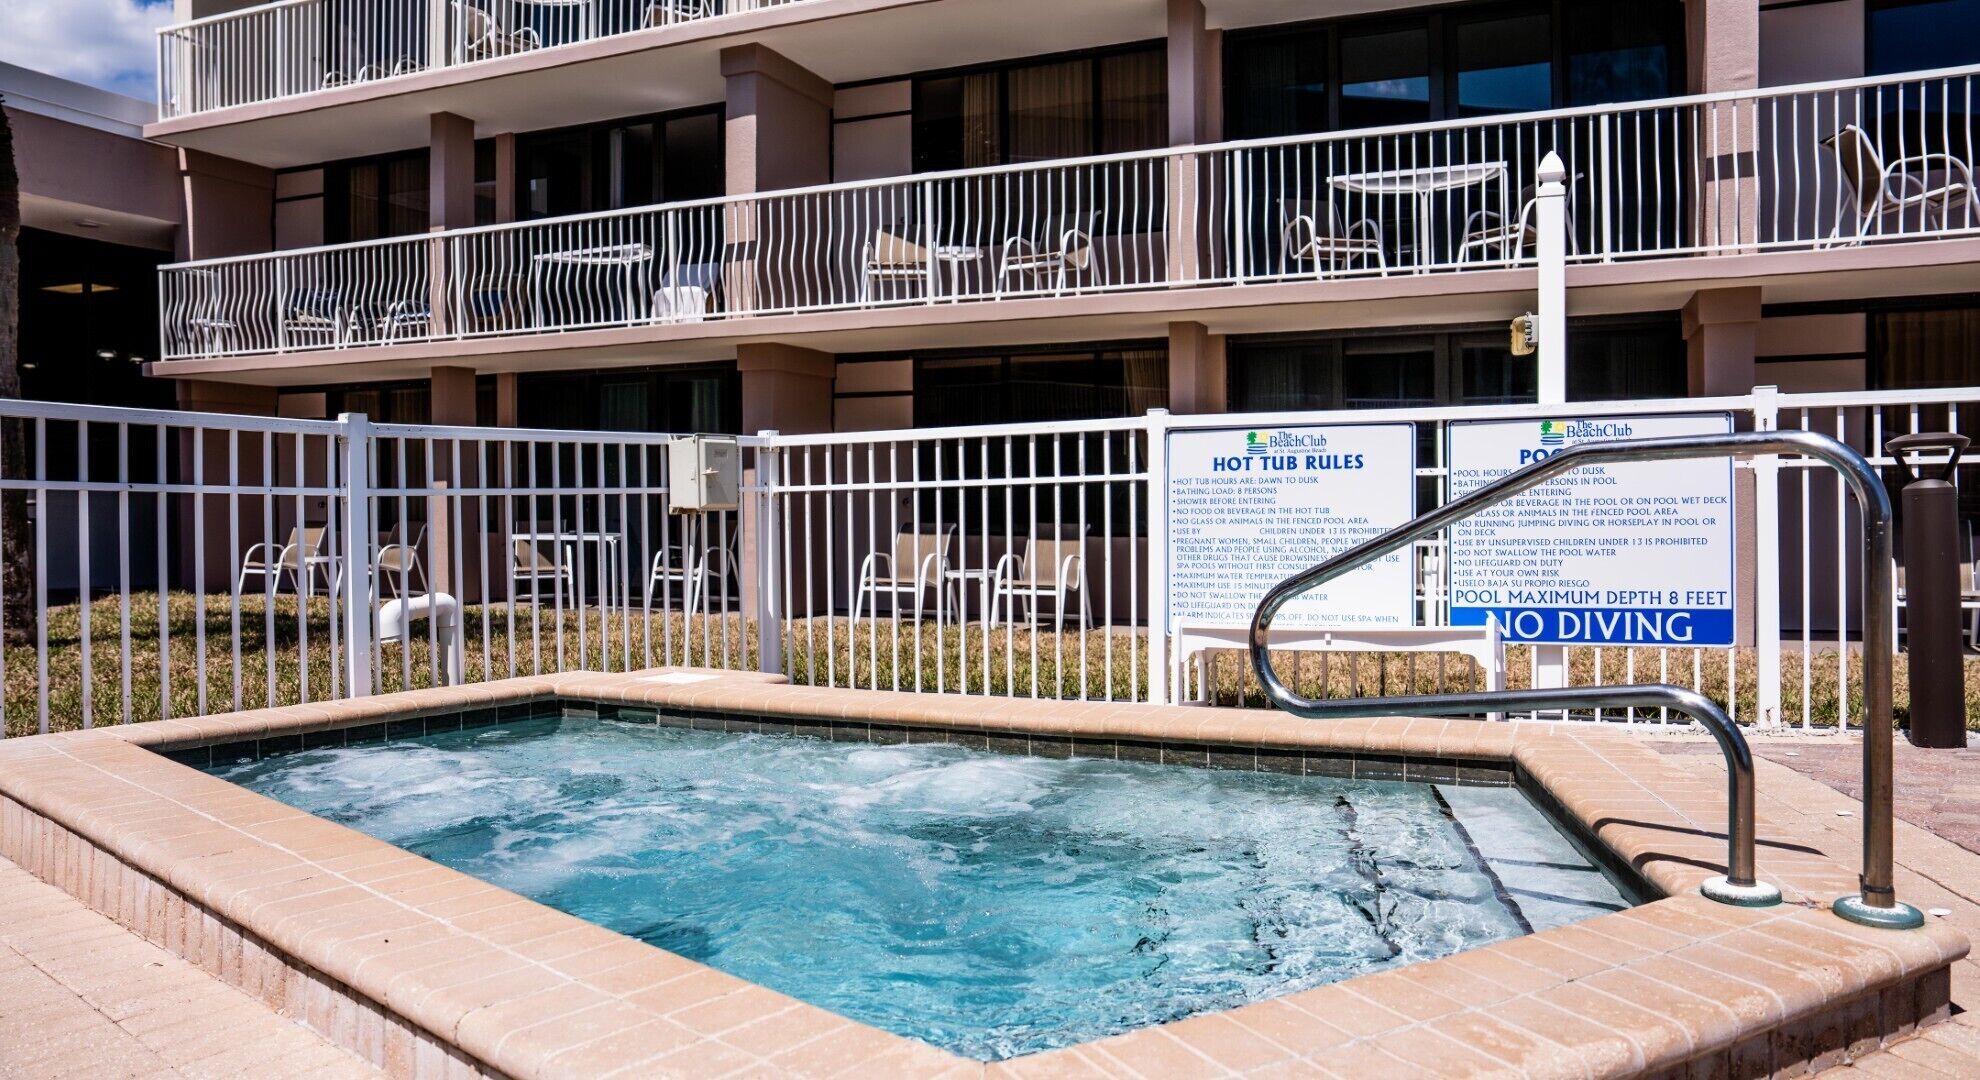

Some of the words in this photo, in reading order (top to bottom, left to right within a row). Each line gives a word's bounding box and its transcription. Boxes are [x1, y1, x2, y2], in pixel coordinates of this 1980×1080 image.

[1576, 419, 1593, 428] The
[1278, 431, 1293, 439] The
[1566, 424, 1633, 437] BeachClub
[1269, 435, 1327, 447] BeachClub
[1213, 457, 1253, 471] HOT
[1260, 456, 1298, 470] TUB
[1306, 454, 1364, 469] RULES
[1298, 476, 1319, 484] DUSK
[1593, 477, 1617, 485] POOL
[1703, 496, 1727, 504] DECK
[1591, 508, 1624, 516] FENCED
[1518, 520, 1556, 528] JUMPING
[1558, 519, 1590, 527] DIVING
[1662, 518, 1671, 526] IN
[1456, 590, 1502, 603] POOL
[1508, 591, 1600, 604] MAXIMUM
[1607, 591, 1661, 604] DEPTH
[1669, 591, 1679, 605] 8
[1686, 591, 1727, 605] FEET
[1191, 602, 1231, 610] LIFEGUARD
[1486, 610, 1544, 639] NO
[1558, 611, 1693, 641] DIVING
